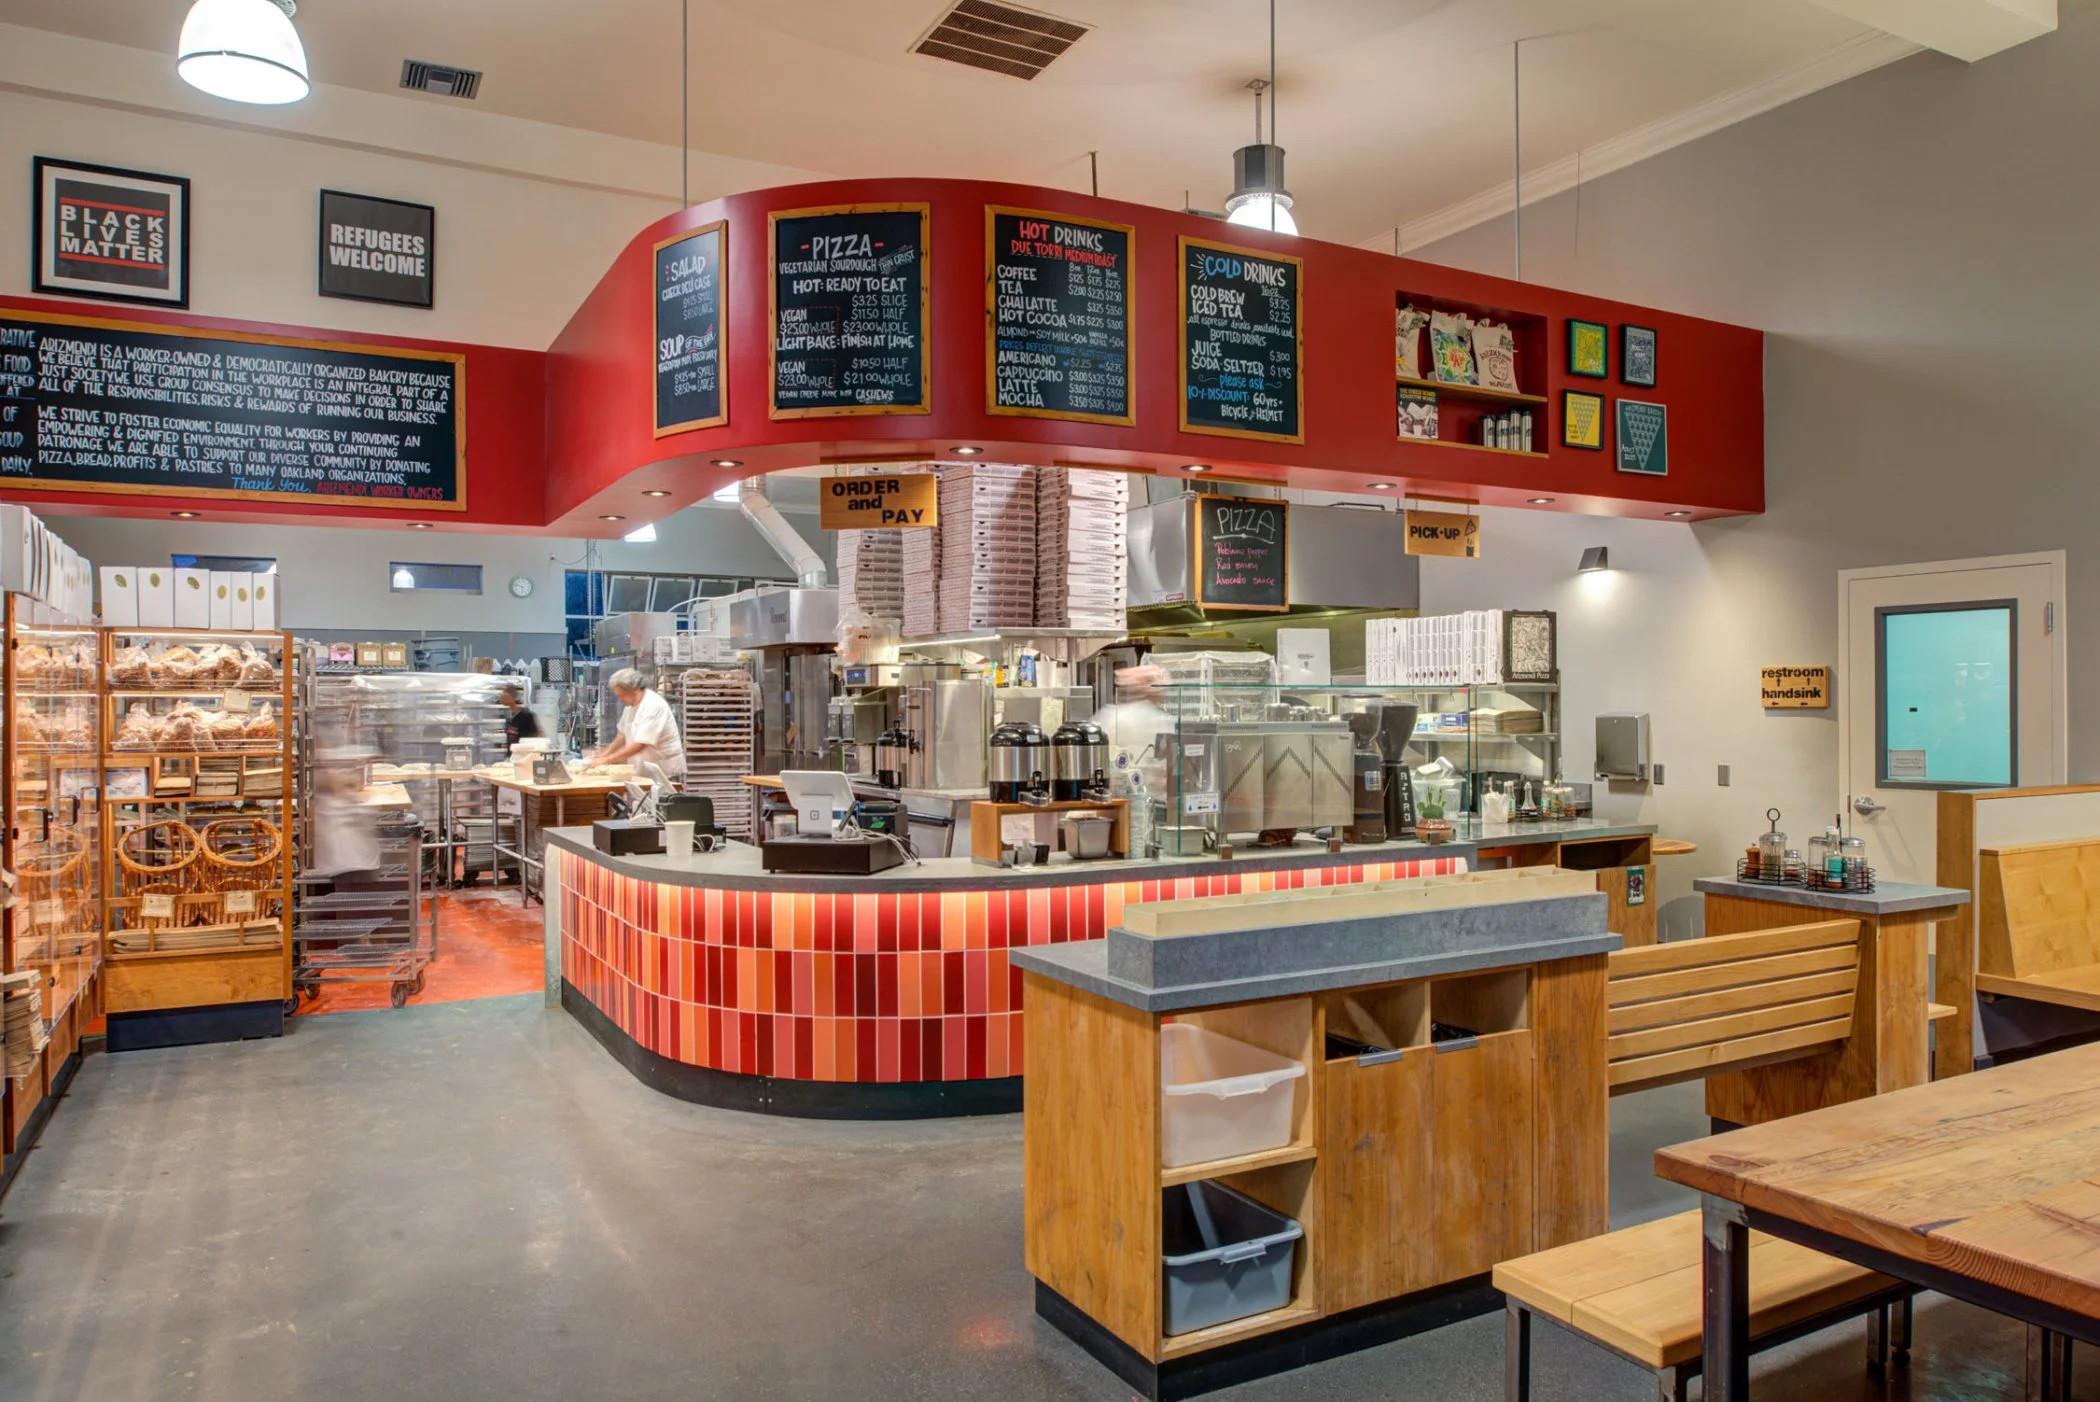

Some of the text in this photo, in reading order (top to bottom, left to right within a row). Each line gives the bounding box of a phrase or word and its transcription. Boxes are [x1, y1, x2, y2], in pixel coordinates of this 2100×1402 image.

[60, 204, 164, 233] BLACK
[60, 220, 164, 248] LIVES
[330, 224, 425, 255] REFUGEES
[1020, 221, 1103, 252] HOT DRINKS
[60, 236, 164, 264] MATTER
[812, 234, 873, 259] PIZZA
[1011, 240, 1063, 258] DUE TORRI
[329, 245, 425, 277] WELCOME
[671, 255, 706, 281] SALAD
[779, 258, 877, 274] VEGETARIAN SOURDOUGH
[997, 264, 1038, 281] COFFEE
[1205, 255, 1286, 287] COLD DRINKS
[826, 277, 862, 292] READY
[863, 278, 879, 291] TO
[881, 277, 907, 292] EAT
[998, 280, 1023, 295] TEA
[881, 295, 908, 307] SLICE
[1191, 284, 1217, 300] COLD
[1218, 288, 1245, 305] BREW
[998, 295, 1058, 313] CHAI LATTE
[1192, 299, 1217, 315] ICED
[1219, 304, 1243, 320] TEA
[781, 309, 807, 322] VEGAN
[883, 307, 906, 320] HALF
[998, 310, 1068, 328] HOT COCOA
[810, 321, 836, 334] WHOLE
[876, 321, 909, 335] WHOLE
[997, 326, 1029, 338] ALMOND
[776, 335, 807, 351] LIGHT
[873, 335, 885, 348] AT
[888, 335, 915, 349] HOME
[1210, 329, 1266, 347] BOTTLED DRINKS
[660, 334, 684, 360] SOUP
[1191, 340, 1222, 357] JUICE
[4, 354, 31, 372] FOOD
[40, 337, 96, 356] ARIZMENDI
[226, 355, 313, 377] DEMOCRATICALLY
[314, 364, 366, 381] ORGANIZED
[369, 369, 408, 385] BAKERY
[409, 374, 451, 389] BECAUSE
[778, 361, 806, 374] VEGAN
[883, 357, 909, 370] HALF
[998, 350, 1057, 368] AMERICANO
[1191, 355, 1265, 377] SODA SELTZER
[38, 351, 437, 399] WE BELIEVE THAT PARTICIPATION IN THE WORKPLACE AN INTEGRAL PART OF
[807, 376, 834, 389] WHOLE
[879, 373, 913, 387] WHOLE
[1220, 373, 1265, 390] please ask
[38, 364, 69, 379] JUST
[134, 374, 155, 387] USE
[158, 376, 189, 390] GROUP
[192, 380, 253, 396] CONSENSUS
[258, 385, 271, 398] TO
[274, 388, 300, 400] MAKE
[304, 390, 352, 404] DECISIONS
[355, 394, 366, 406] IN
[368, 396, 397, 409] ORDER
[401, 399, 412, 410] TO
[416, 400, 447, 414] SHARE
[856, 389, 894, 400] CASHEWS
[998, 379, 1039, 394] LATTE
[39, 378, 60, 392] ALL
[63, 380, 78, 394] OF
[83, 381, 104, 396] THE
[247, 399, 295, 413] REWARDS
[317, 404, 362, 418] RUNNING
[364, 408, 384, 420] OUR
[998, 392, 1045, 408] MOCHA
[1256, 407, 1283, 421] HELMET
[37, 404, 421, 447] WE STRIVE FOSTER ECONOMIC EQUALITY FOR WORKERS PROVIDING AN
[38, 420, 398, 458] EMPOWERING DIGNIFIED THROUGH YOUR CONTINUING
[38, 434, 431, 474] PATRONAGE ARE ABLE TO SUPPORT OUR DIVERSE COMMUNITY DONATING
[114, 455, 157, 469] PROFITS
[175, 459, 223, 474] PASTRIES
[229, 462, 242, 475] TO
[245, 464, 276, 476] MANY
[281, 466, 324, 480] OAKLAND
[328, 469, 407, 486] ORGANIZATIONS.
[231, 477, 275, 490] Thank
[832, 479, 900, 496] ORDER
[848, 495, 882, 510] and
[882, 509, 924, 523] PAY
[1217, 507, 1275, 540] PIZZA
[1216, 557, 1231, 570] Red
[1216, 571, 1275, 586] Avocado sauce
[1762, 667, 1823, 678] restroom
[1762, 687, 1821, 699] handsink
